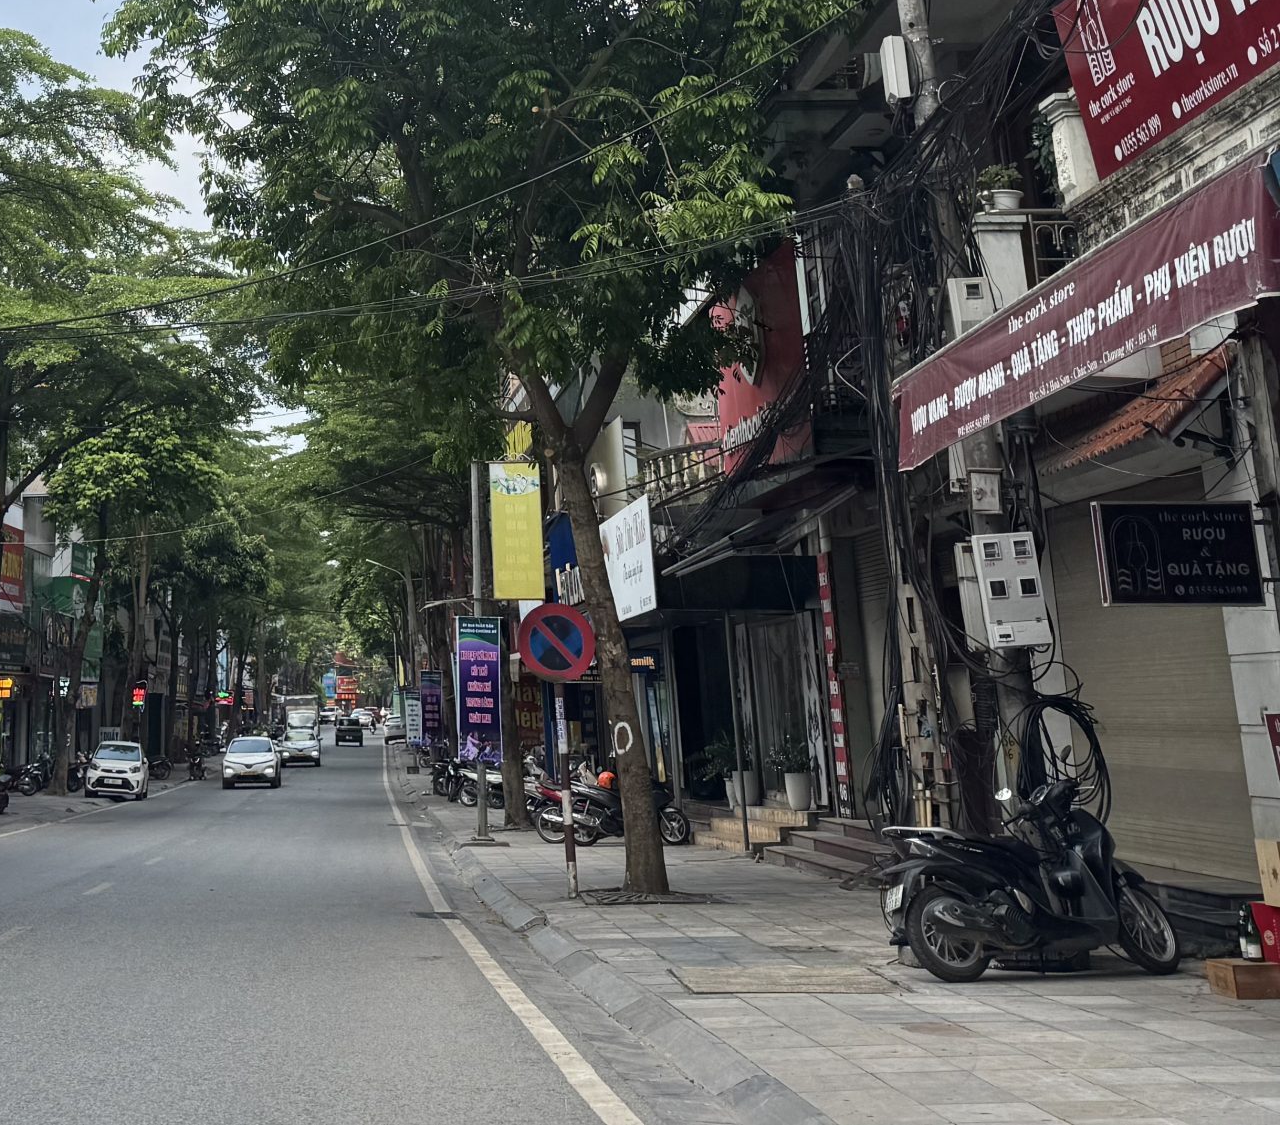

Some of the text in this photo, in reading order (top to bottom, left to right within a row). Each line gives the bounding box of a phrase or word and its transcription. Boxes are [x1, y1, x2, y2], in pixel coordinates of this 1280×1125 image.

[1088, 72, 1136, 118] the cork store
[1180, 63, 1239, 114] thecorkstore.vn
[1007, 281, 1076, 335] the cork store
[953, 376, 977, 411] RƯỢU
[977, 361, 1006, 399] MẠNH
[1010, 341, 1032, 381] QUÀ
[1030, 329, 1060, 371] TẶNG
[1065, 307, 1096, 349] THỰC
[1097, 279, 1134, 332] PHẨM
[1143, 261, 1171, 306] PHỤ
[1173, 241, 1211, 290] KIỆN
[1158, 510, 1246, 523] the cork store
[1182, 527, 1226, 545] RƯỢU
[1200, 546, 1211, 557] &
[1167, 559, 1250, 579] QUÀ TẶNG
[630, 655, 655, 667] amilk
